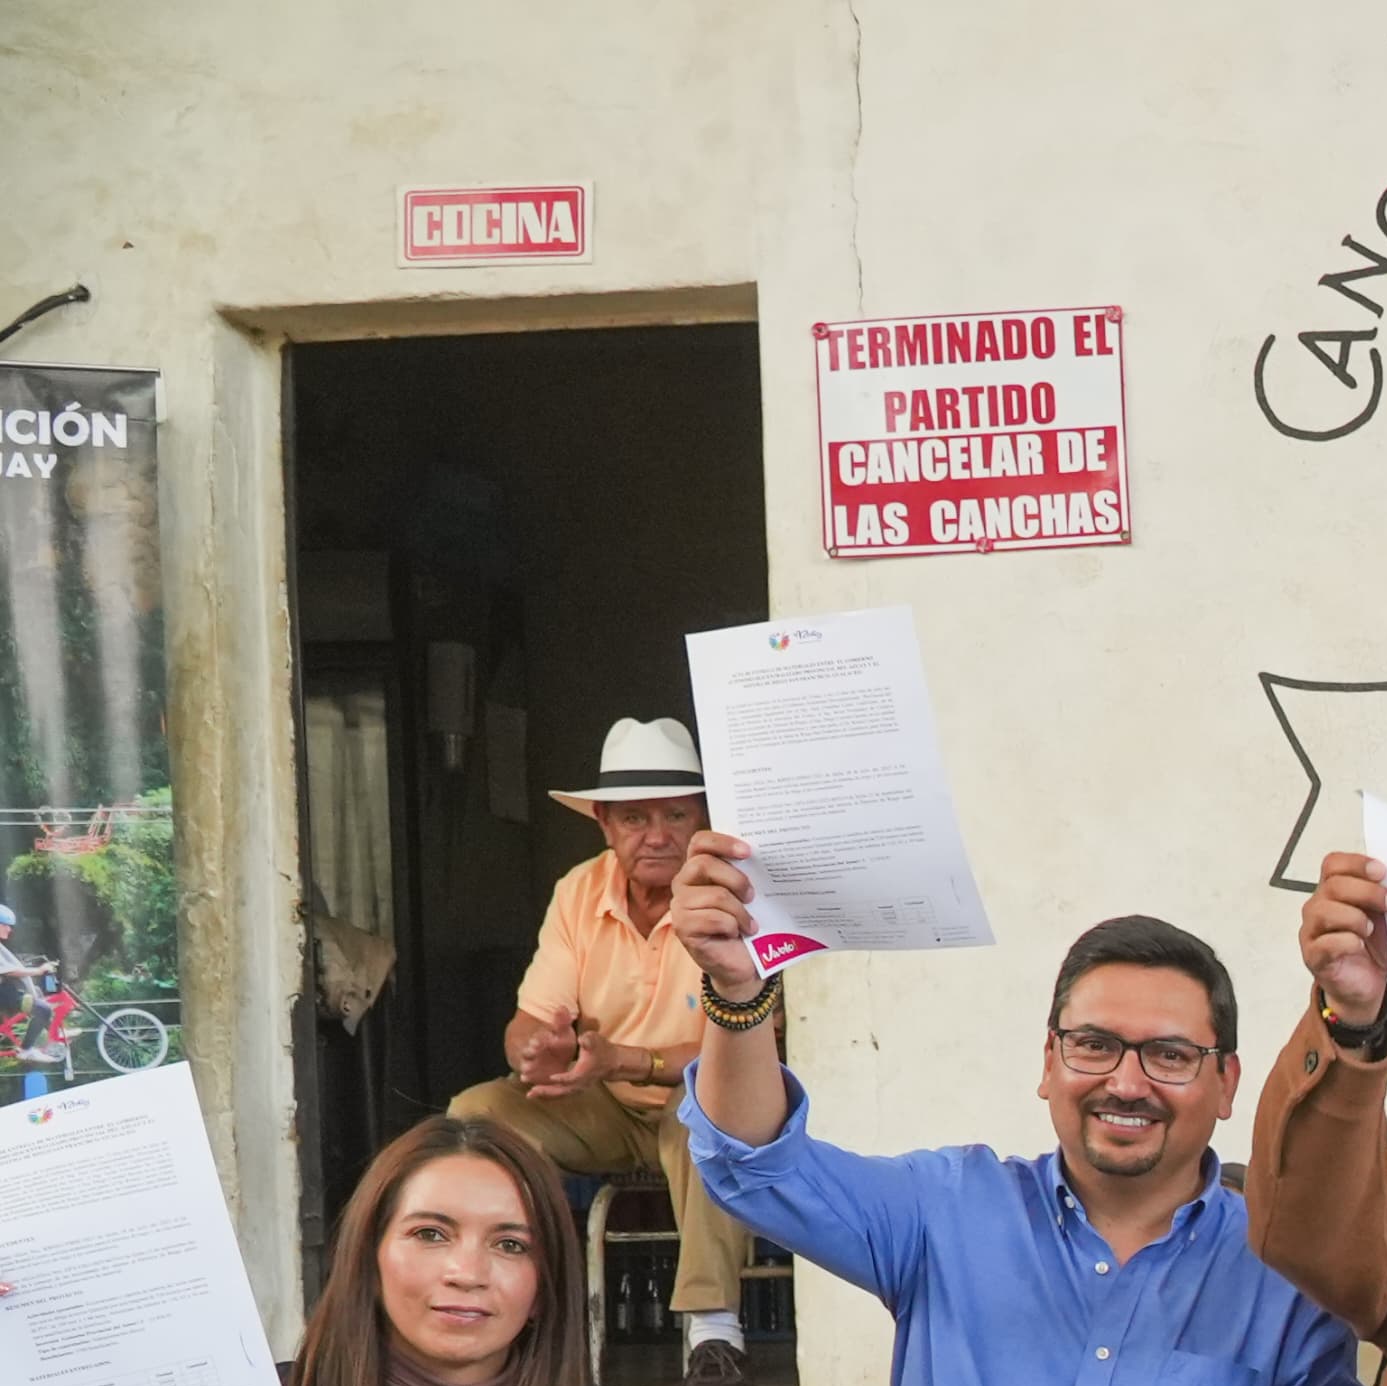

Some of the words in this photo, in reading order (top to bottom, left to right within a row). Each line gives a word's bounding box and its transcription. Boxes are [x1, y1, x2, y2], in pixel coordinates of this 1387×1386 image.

[412, 201, 577, 247] COCINA
[827, 316, 1056, 371] TERMINADO
[1073, 314, 1114, 357] EL
[0, 401, 127, 448] CIÓN
[884, 382, 1056, 432] PARTIDO
[0, 451, 58, 479] AY
[838, 433, 1044, 486] CANCELAR
[1056, 429, 1107, 474] DE
[834, 502, 910, 546] LAS
[929, 489, 1120, 543] CANCHAS
